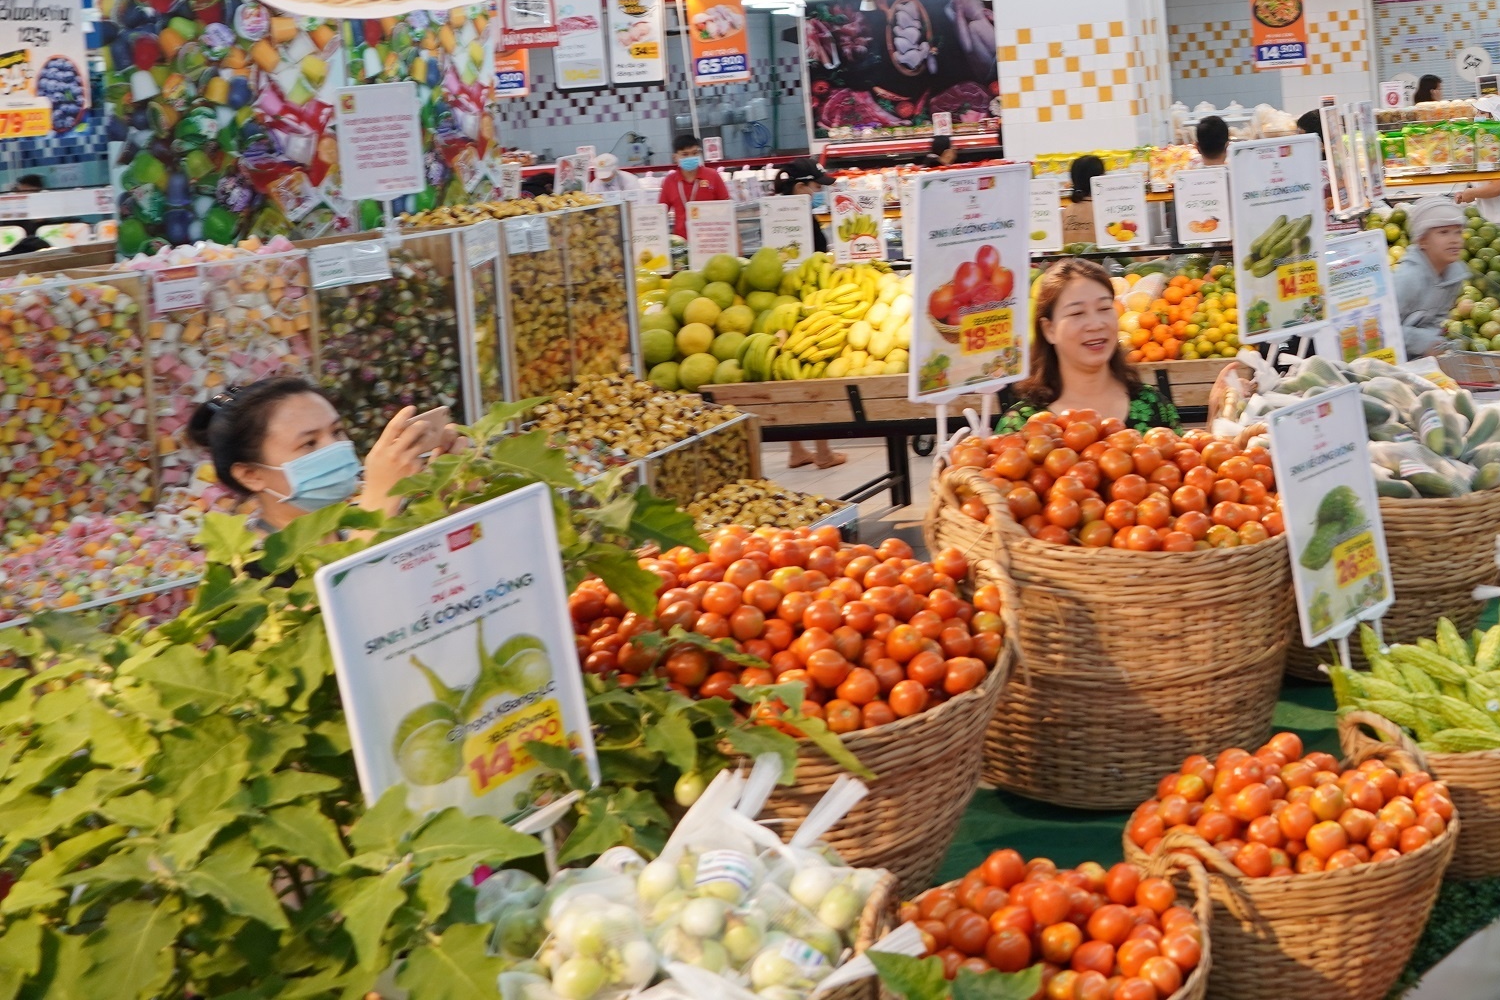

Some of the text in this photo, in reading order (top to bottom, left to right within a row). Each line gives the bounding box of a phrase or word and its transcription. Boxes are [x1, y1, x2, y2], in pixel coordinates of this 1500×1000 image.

[391, 540, 441, 565] CENTRAL
[400, 552, 437, 571] RETAIL
[364, 626, 408, 656] SINH
[411, 609, 431, 633] KẾ
[433, 594, 484, 624] CỘNG
